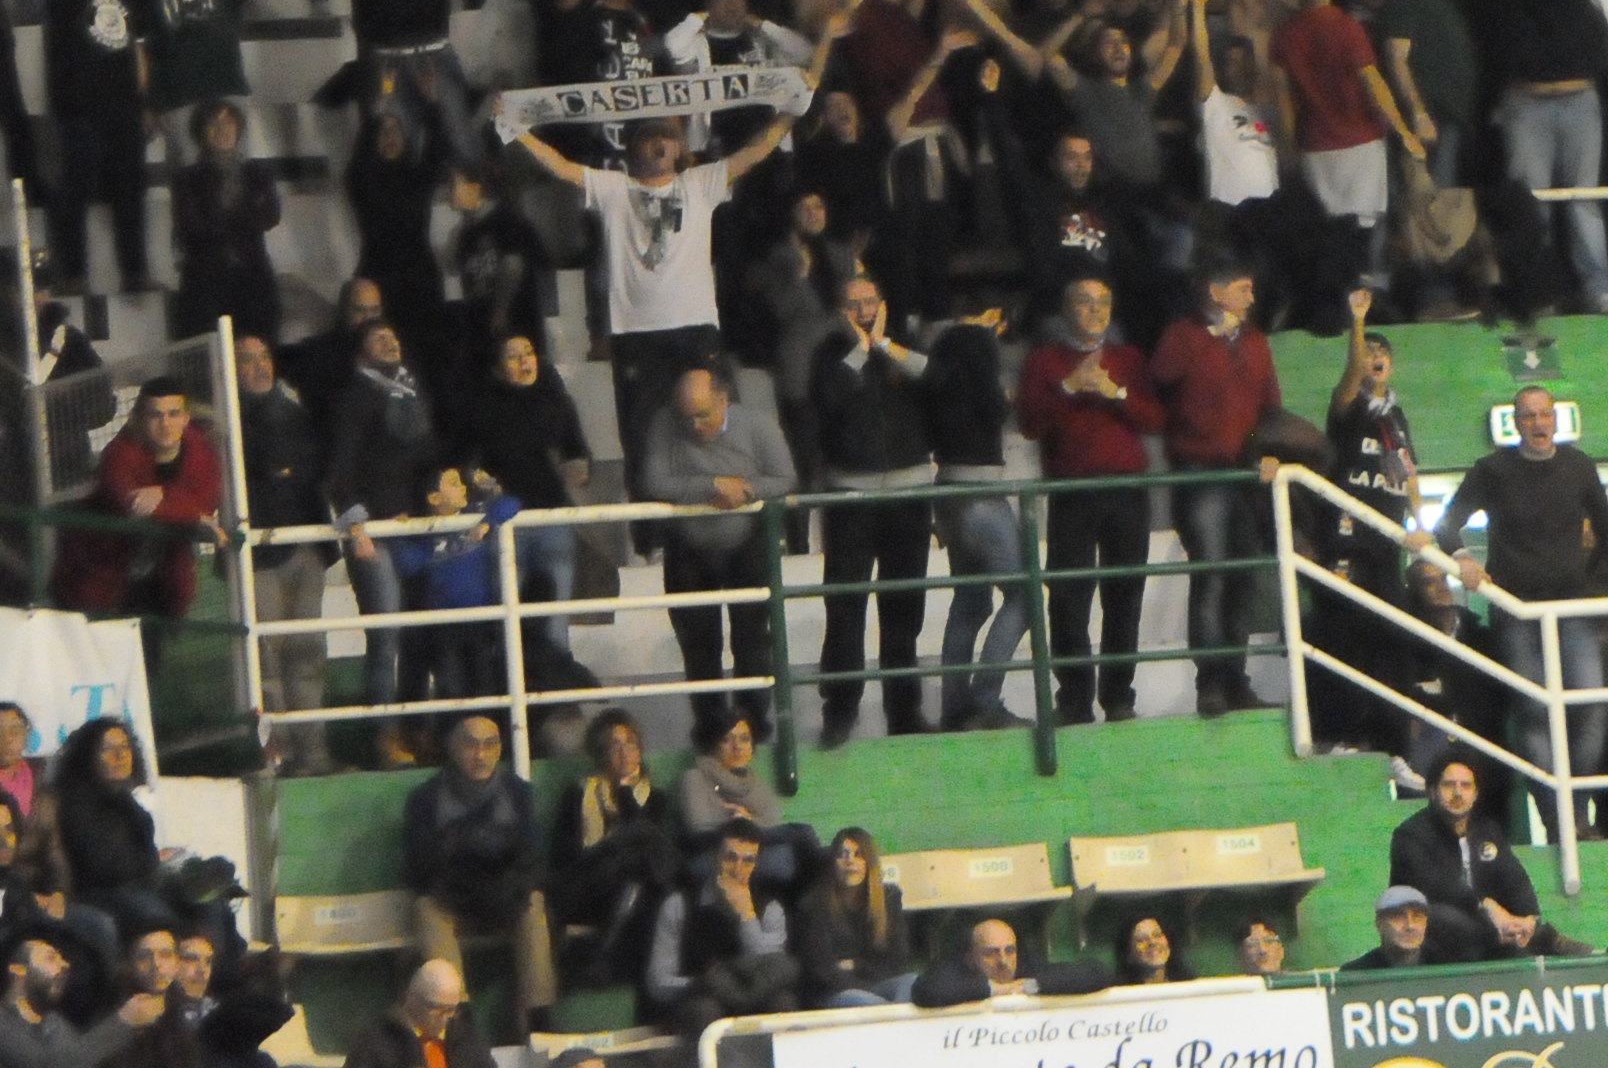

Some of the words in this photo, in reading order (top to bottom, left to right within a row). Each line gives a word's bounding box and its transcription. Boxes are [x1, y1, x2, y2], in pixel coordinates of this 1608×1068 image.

[556, 74, 750, 118] CASERTA
[942, 1027, 961, 1049] il
[969, 1019, 1060, 1047] Piccolo
[1067, 1010, 1169, 1040] Castello
